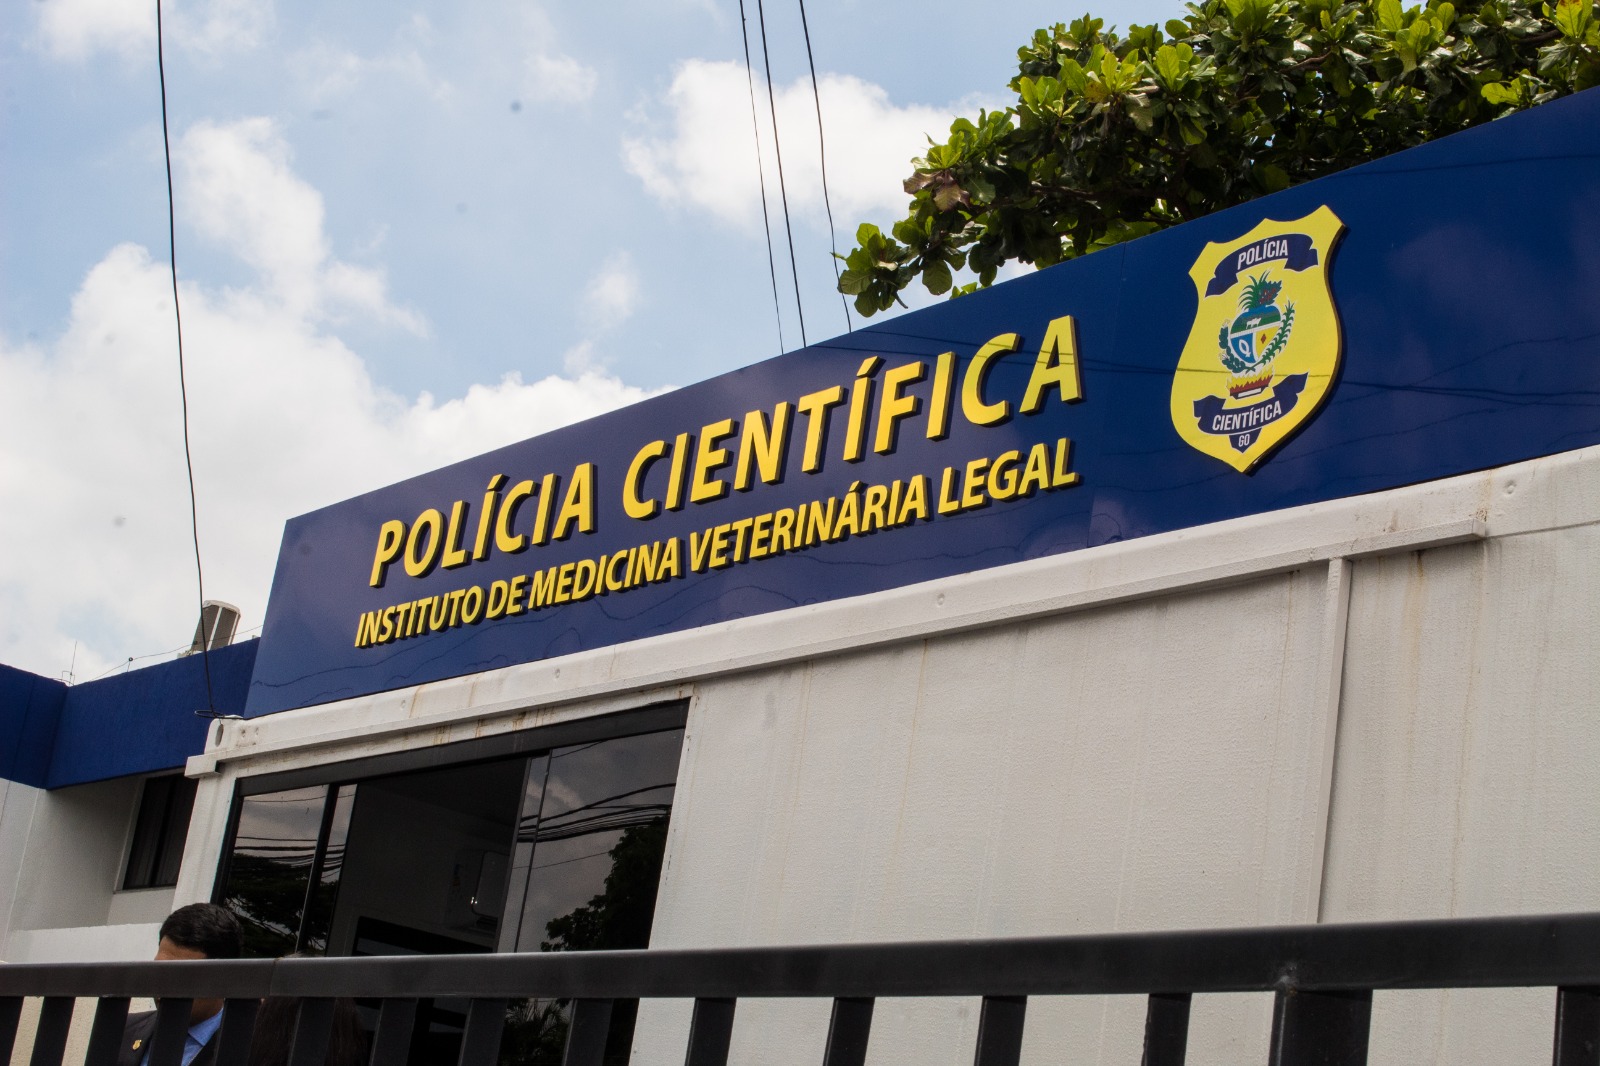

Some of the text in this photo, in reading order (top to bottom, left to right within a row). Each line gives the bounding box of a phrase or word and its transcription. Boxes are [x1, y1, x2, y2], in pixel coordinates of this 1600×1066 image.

[1237, 239, 1288, 270] POLÍCIA
[1212, 400, 1282, 431] CIENTÍFICA
[370, 316, 1080, 586] POLÍCIA CIENTÍFICA
[1238, 434, 1250, 448] GO
[355, 438, 1077, 648] INSTITUTO DE MEDICINA VETERINÁRIA LEGAL
